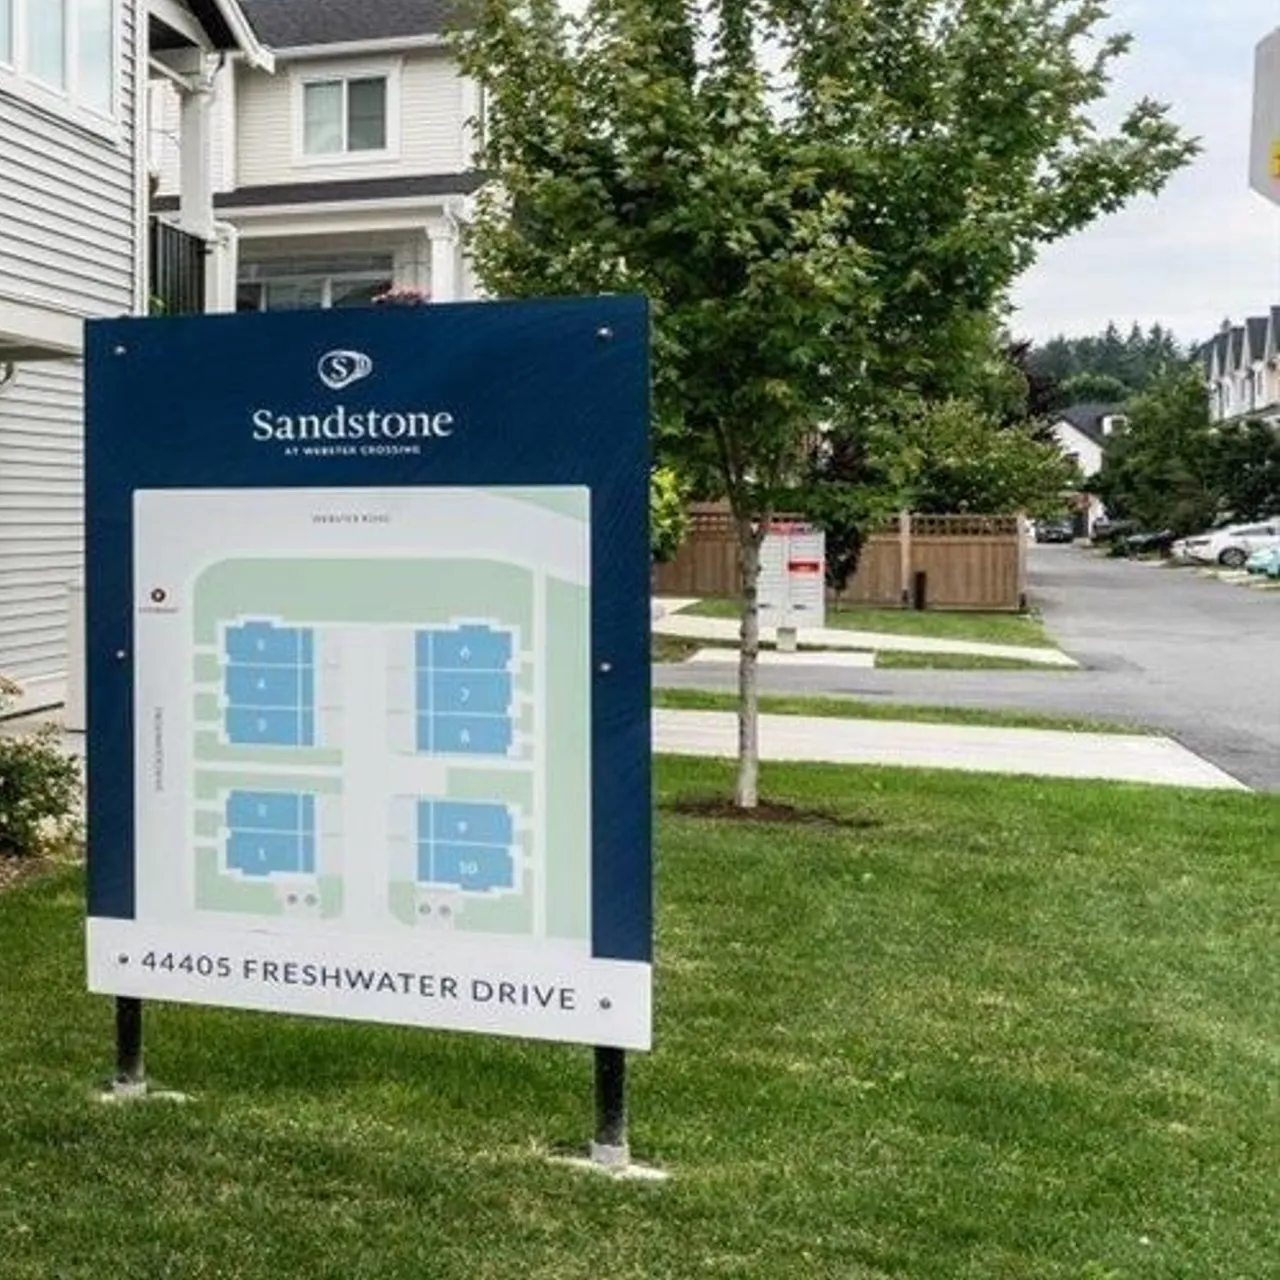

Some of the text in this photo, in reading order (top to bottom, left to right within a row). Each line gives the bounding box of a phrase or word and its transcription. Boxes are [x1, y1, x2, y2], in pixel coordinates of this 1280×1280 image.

[251, 404, 454, 441] Sandstone
[284, 443, 421, 456] AT WEBSTER CROSSING
[141, 951, 576, 1010] 44405 FRESHWATER DRIVE
